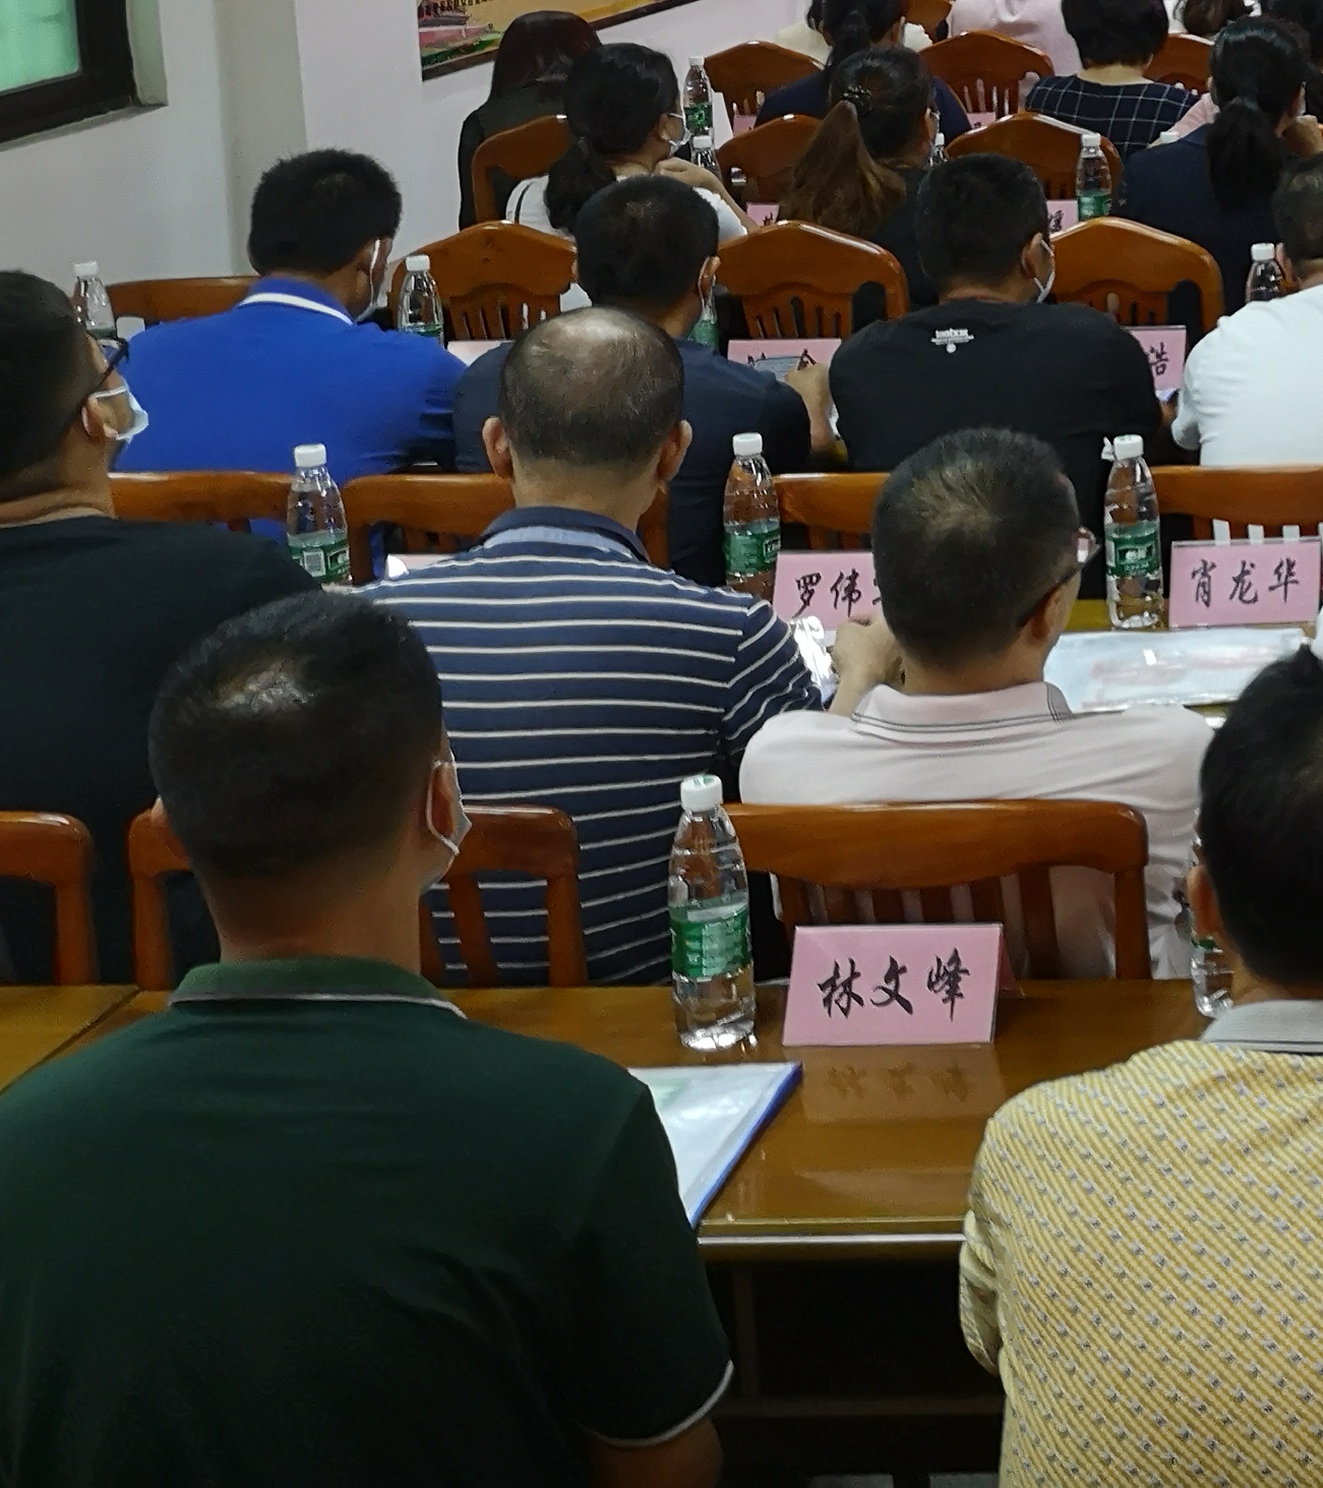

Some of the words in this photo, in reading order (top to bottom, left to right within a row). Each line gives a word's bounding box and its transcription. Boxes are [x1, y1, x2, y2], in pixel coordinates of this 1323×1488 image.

[793, 566, 878, 619] 罗伟
[1190, 558, 1300, 609] 肖龙华
[817, 947, 969, 1022] 林文峰
